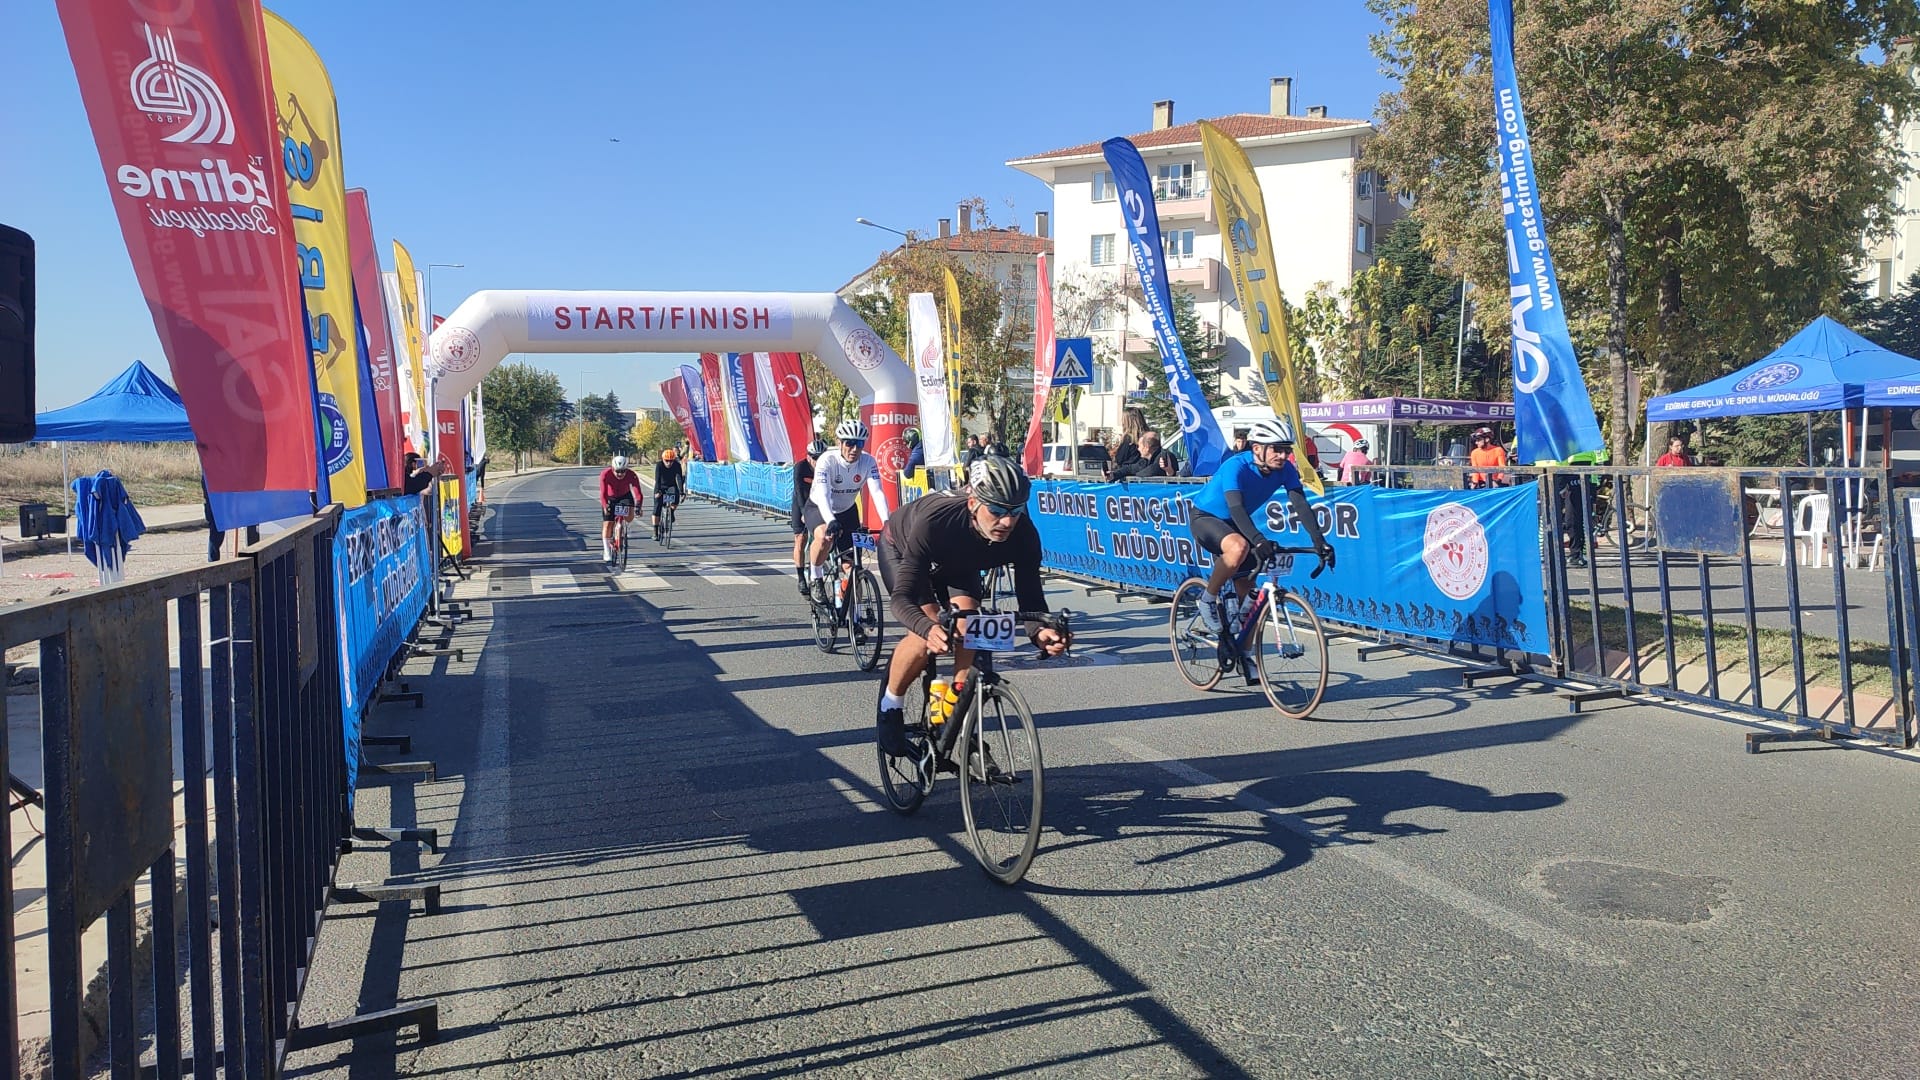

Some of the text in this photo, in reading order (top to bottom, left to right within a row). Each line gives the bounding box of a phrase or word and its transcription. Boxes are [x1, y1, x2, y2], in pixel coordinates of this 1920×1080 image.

[1500, 88, 1556, 311] www.gatetiming.com
[554, 306, 770, 331] START/FINISH
[1131, 243, 1190, 382] www.gatetiming.com
[1725, 397, 1735, 405] VE
[1737, 395, 1758, 405] SPOR
[870, 410, 918, 426] EDİRNE
[1037, 487, 1099, 520] EDİRNE
[853, 533, 875, 547] 379
[1086, 522, 1215, 569] İL MÜDÜRL
[966, 617, 1013, 640] 409
